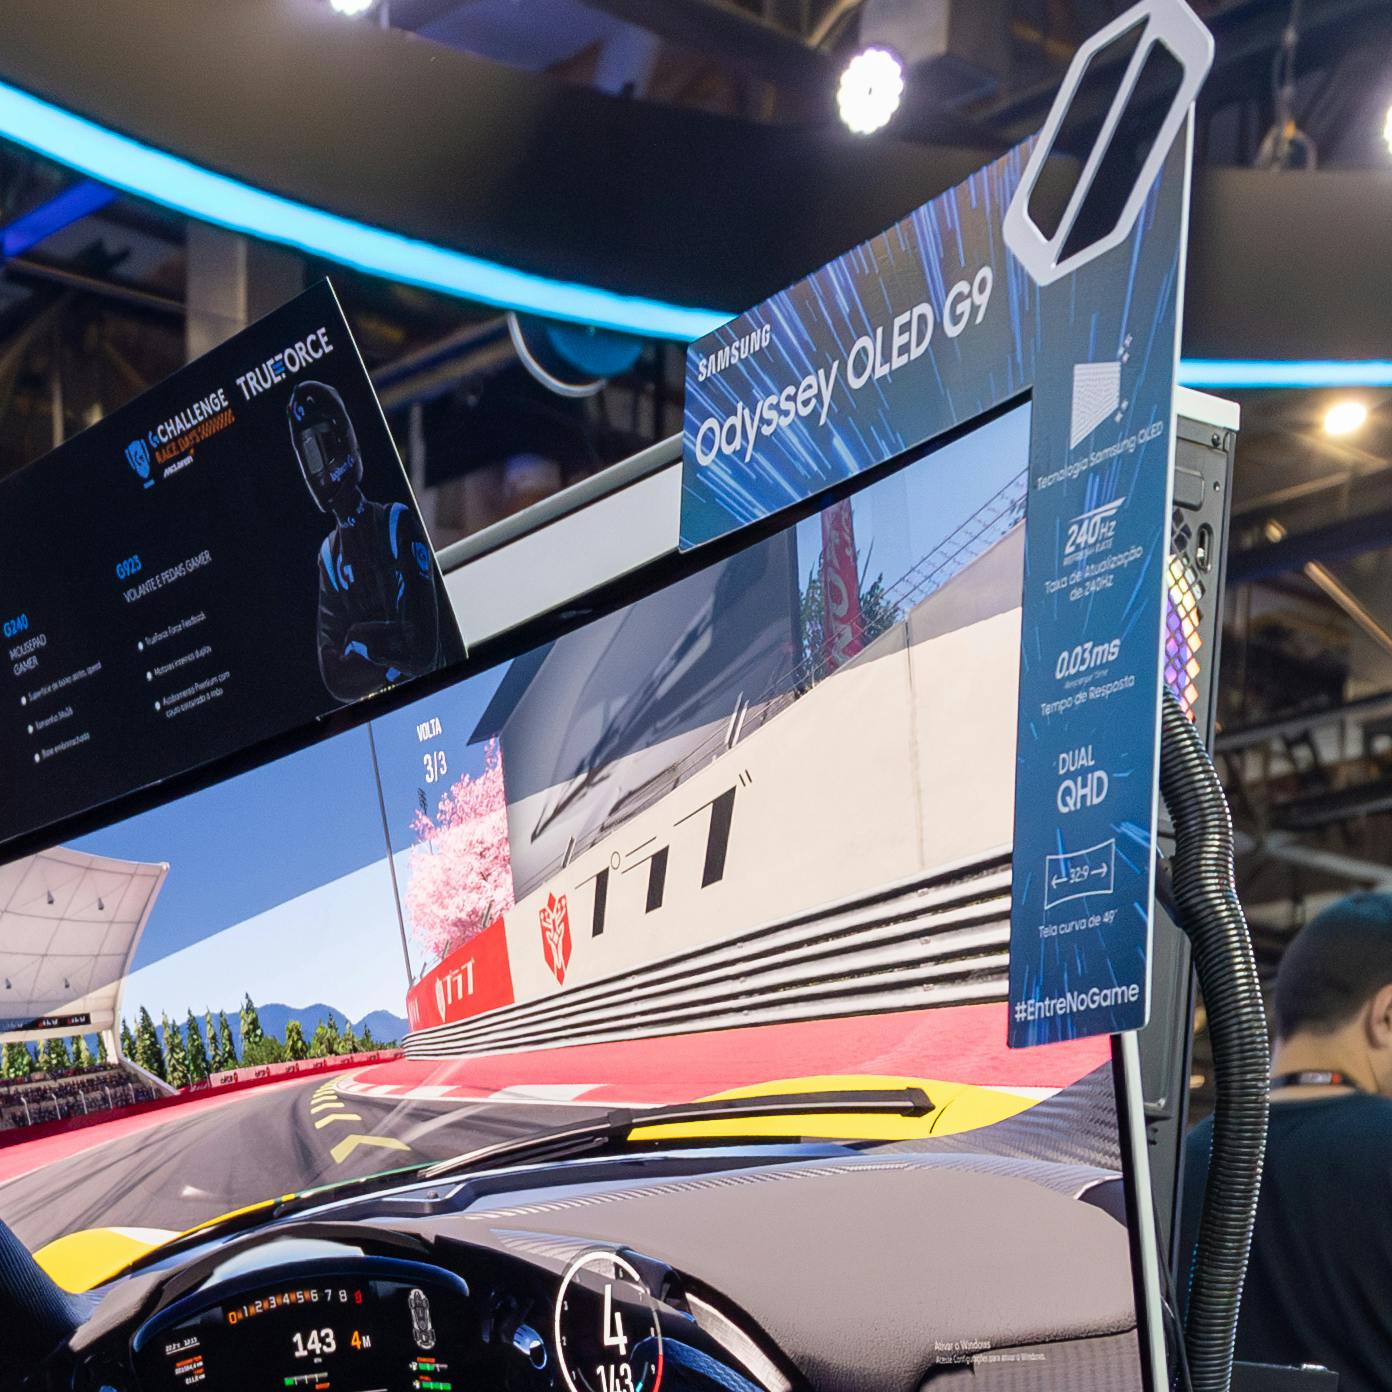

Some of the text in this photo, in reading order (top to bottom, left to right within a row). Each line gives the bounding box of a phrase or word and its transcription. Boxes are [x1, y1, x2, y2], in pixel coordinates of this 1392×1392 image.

[235, 326, 334, 401] TRUEFORCE
[695, 265, 994, 467] Odyssey OLED G9
[697, 323, 771, 383] SAMSUNG
[157, 388, 229, 443] CHALLENGE
[1036, 420, 1164, 491] Tecnologia Samsung OLED
[115, 554, 142, 580] G923
[122, 577, 157, 603] VOLANTE
[185, 549, 212, 572] GAMER
[1044, 545, 1144, 595] Taxa de Atualização
[1069, 585, 1084, 601] de
[3, 613, 30, 638] G240
[13, 655, 39, 676] GAMER
[1055, 638, 1121, 680] 0.03ms
[1040, 674, 1136, 717] Tempo de Resposta
[415, 716, 443, 744] VOLTA
[422, 750, 448, 785] 3/3
[1059, 744, 1096, 775] DUAL
[1057, 770, 1109, 814] QHD
[1038, 924, 1058, 939] Tela
[1058, 920, 1088, 936] curva
[1087, 914, 1101, 928] de
[1014, 983, 1139, 1023] #EntreNoGame
[228, 1310, 238, 1326] 0
[242, 1304, 249, 1318] 1
[255, 1300, 264, 1314] 2
[268, 1295, 277, 1309] 3
[282, 1292, 290, 1306] 4
[296, 1290, 305, 1304] 5
[310, 1289, 319, 1303] 6
[324, 1288, 333, 1302] 7
[338, 1289, 348, 1303] 8
[602, 1283, 629, 1356] 4
[292, 1327, 337, 1359] 143
